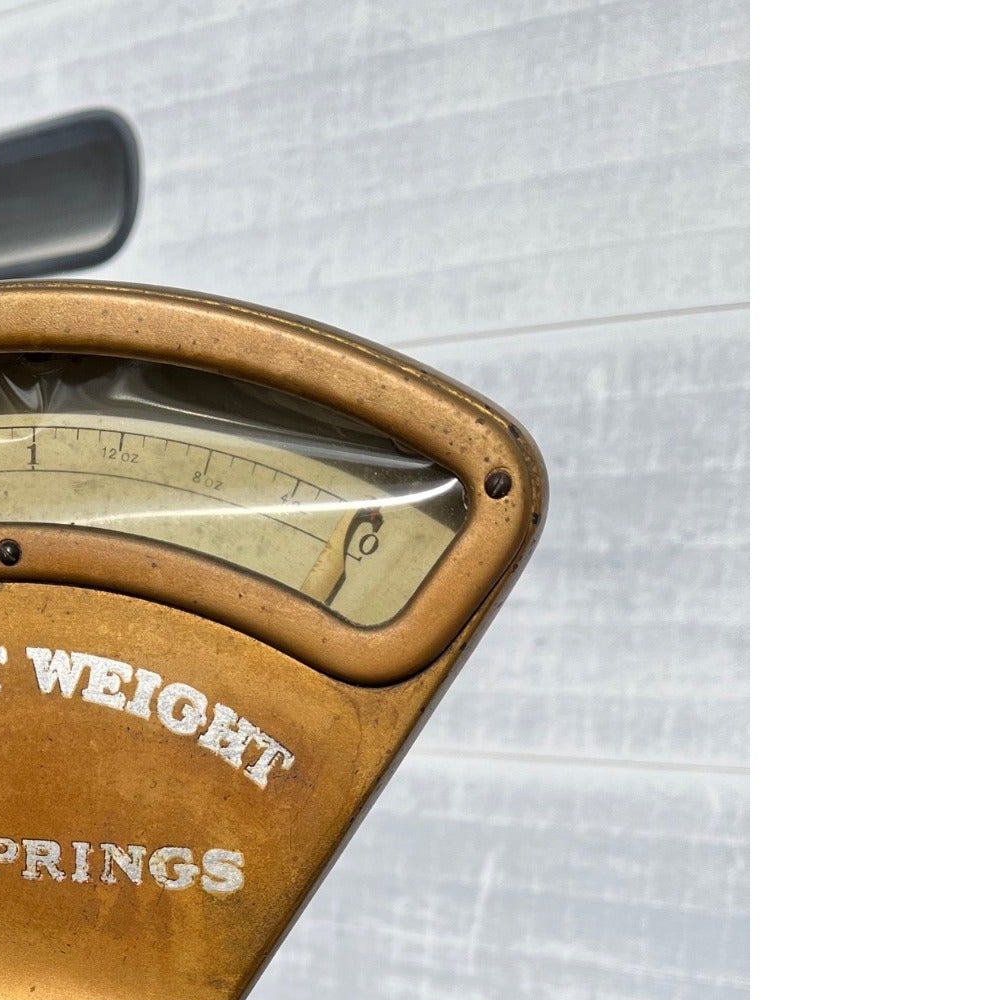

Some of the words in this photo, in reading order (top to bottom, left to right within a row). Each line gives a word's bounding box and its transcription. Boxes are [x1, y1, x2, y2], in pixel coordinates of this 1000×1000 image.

[26, 444, 38, 466] 1
[102, 446, 117, 460] 12
[192, 471, 201, 483] 8
[26, 646, 295, 790] WEIGHT
